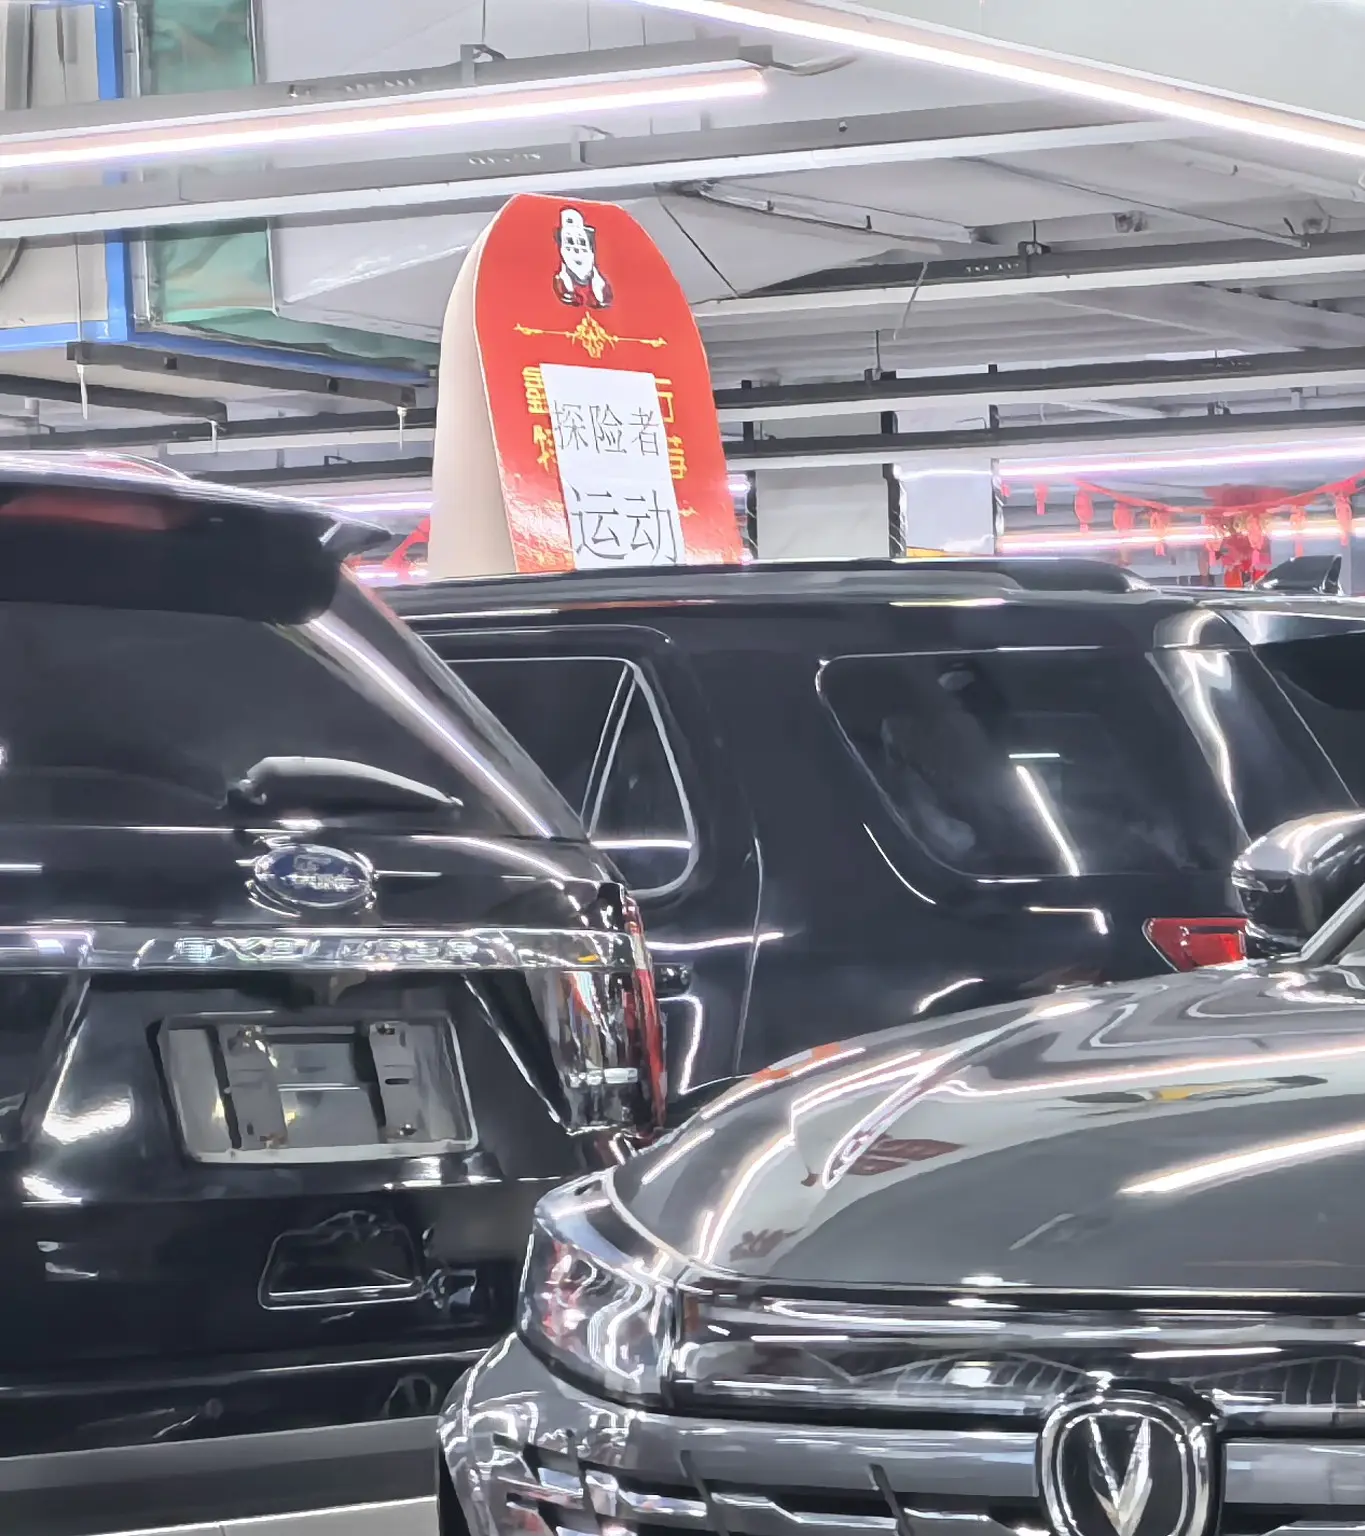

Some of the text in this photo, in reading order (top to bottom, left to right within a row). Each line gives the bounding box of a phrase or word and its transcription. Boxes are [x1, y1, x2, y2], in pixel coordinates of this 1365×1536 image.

[554, 400, 660, 456] 探险者
[570, 486, 678, 564] 运动
